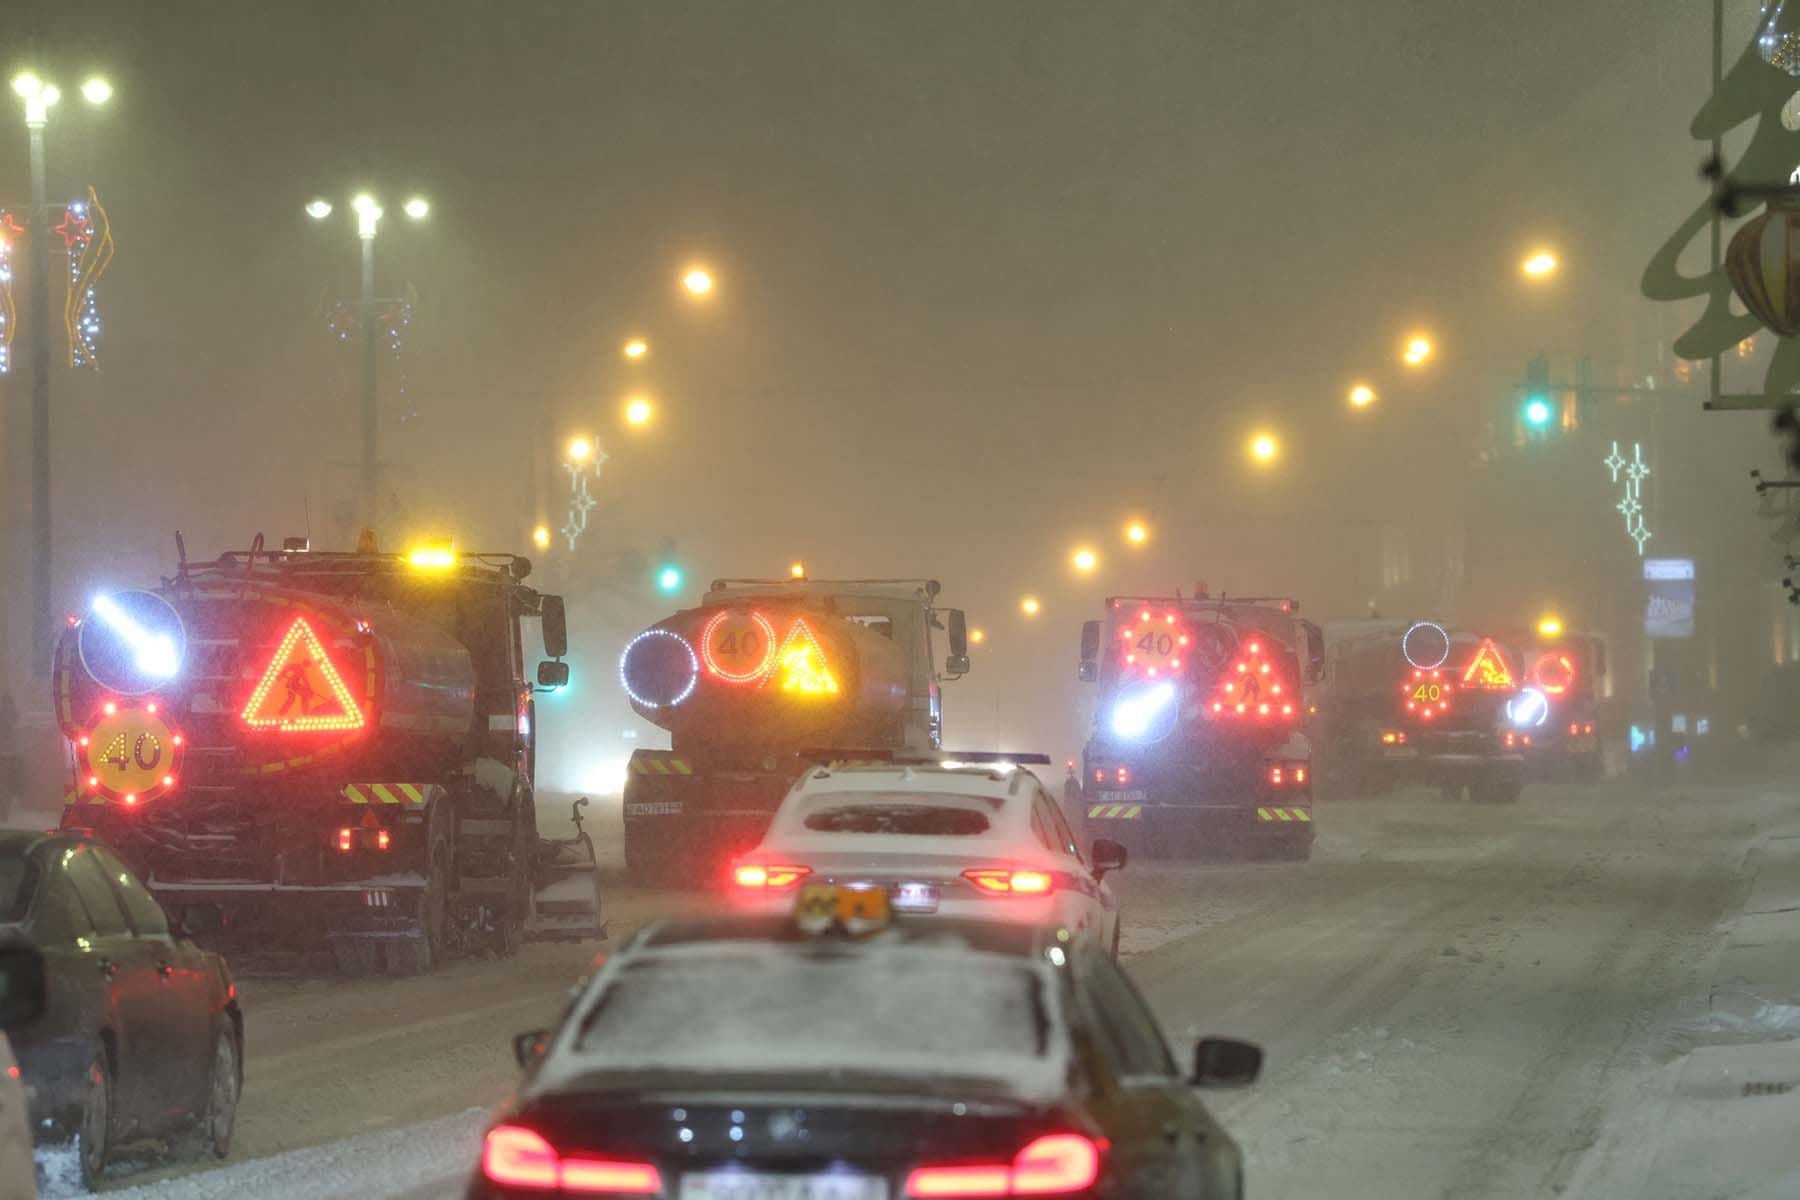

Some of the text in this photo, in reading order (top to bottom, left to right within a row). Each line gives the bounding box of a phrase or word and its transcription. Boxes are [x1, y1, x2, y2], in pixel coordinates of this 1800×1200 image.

[718, 631, 759, 660] 40
[1136, 631, 1173, 656] 40
[1413, 683, 1441, 702] 40
[100, 732, 160, 770] 40
